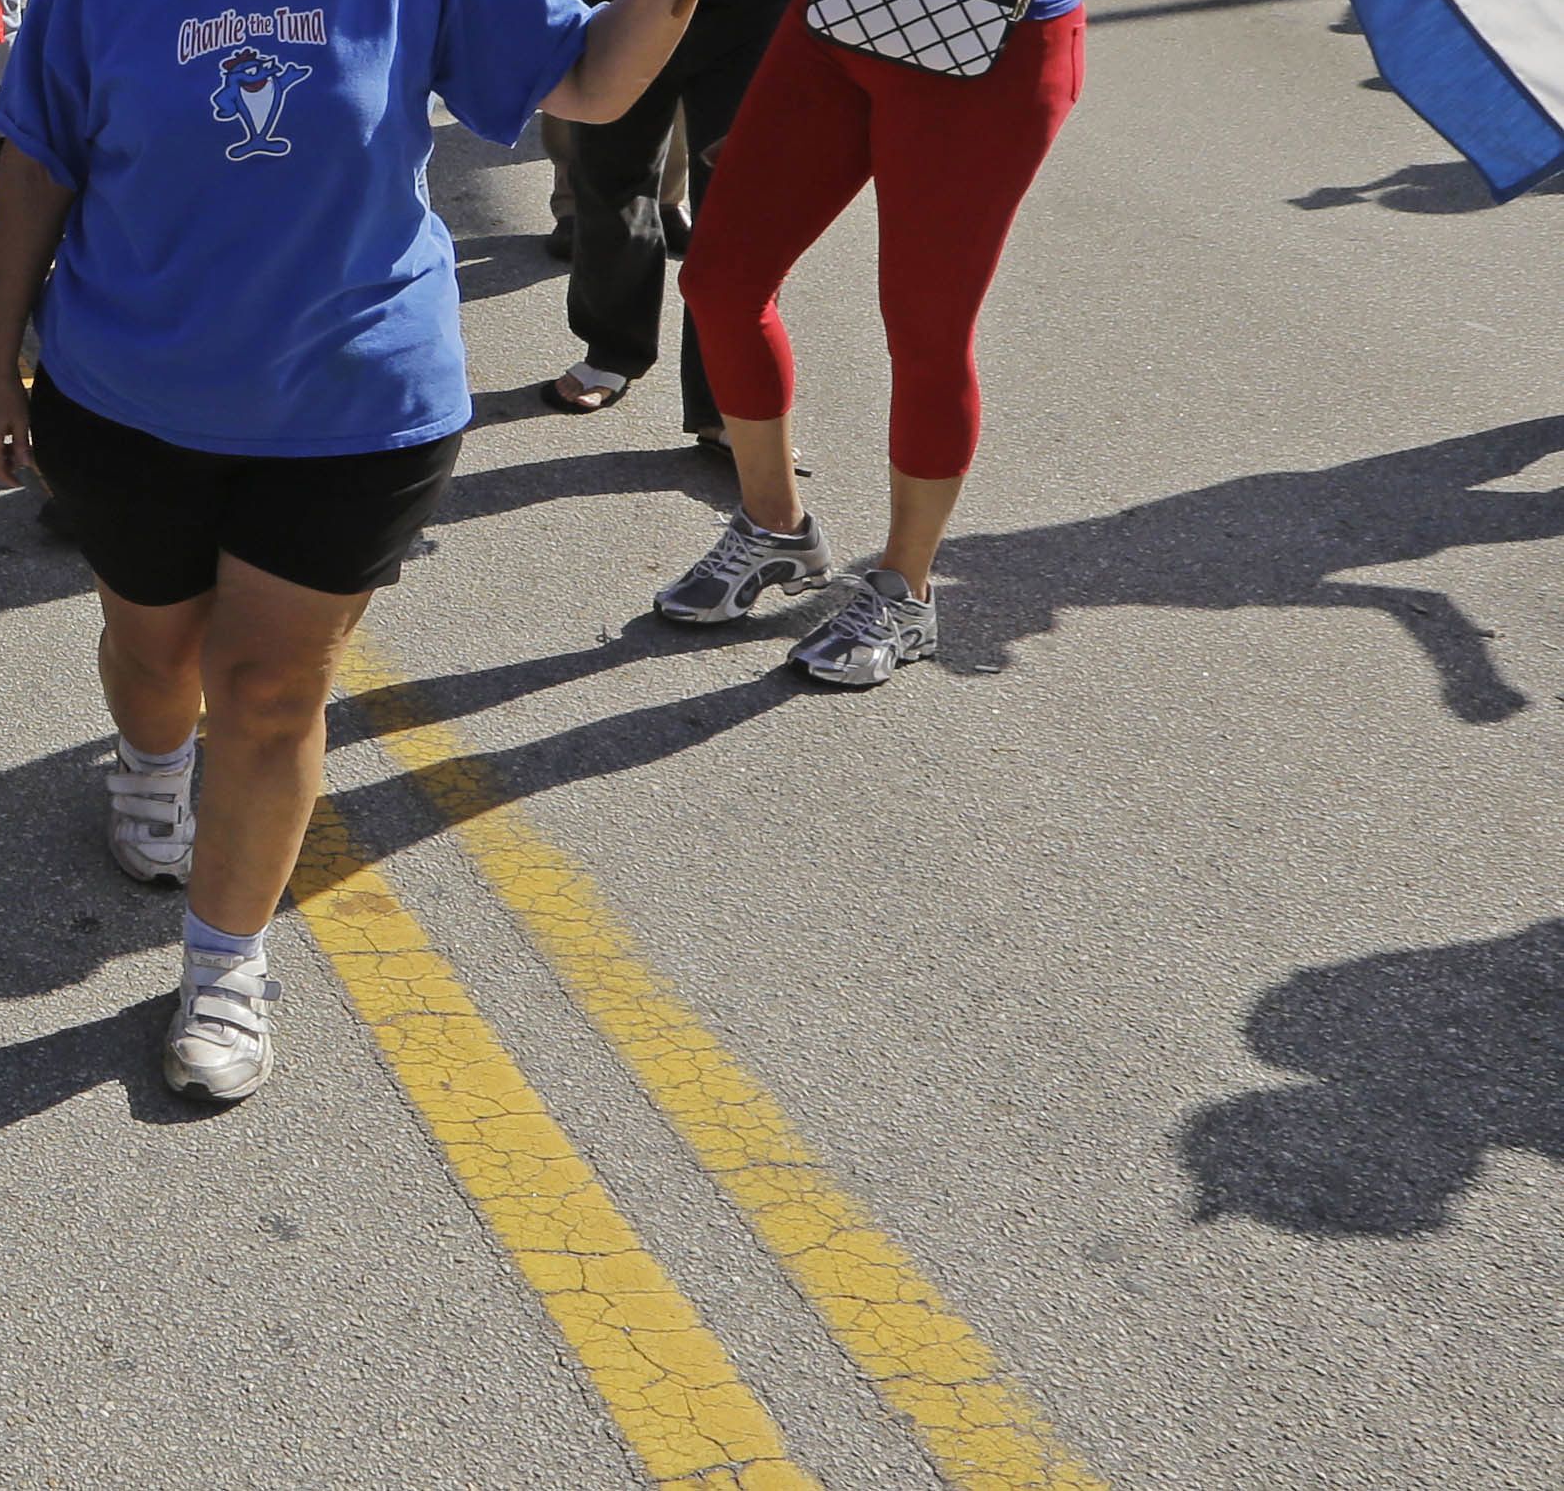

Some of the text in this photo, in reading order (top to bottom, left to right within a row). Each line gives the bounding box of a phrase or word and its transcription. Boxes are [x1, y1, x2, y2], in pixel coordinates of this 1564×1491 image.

[178, 7, 327, 64] Charlie the Tuna
